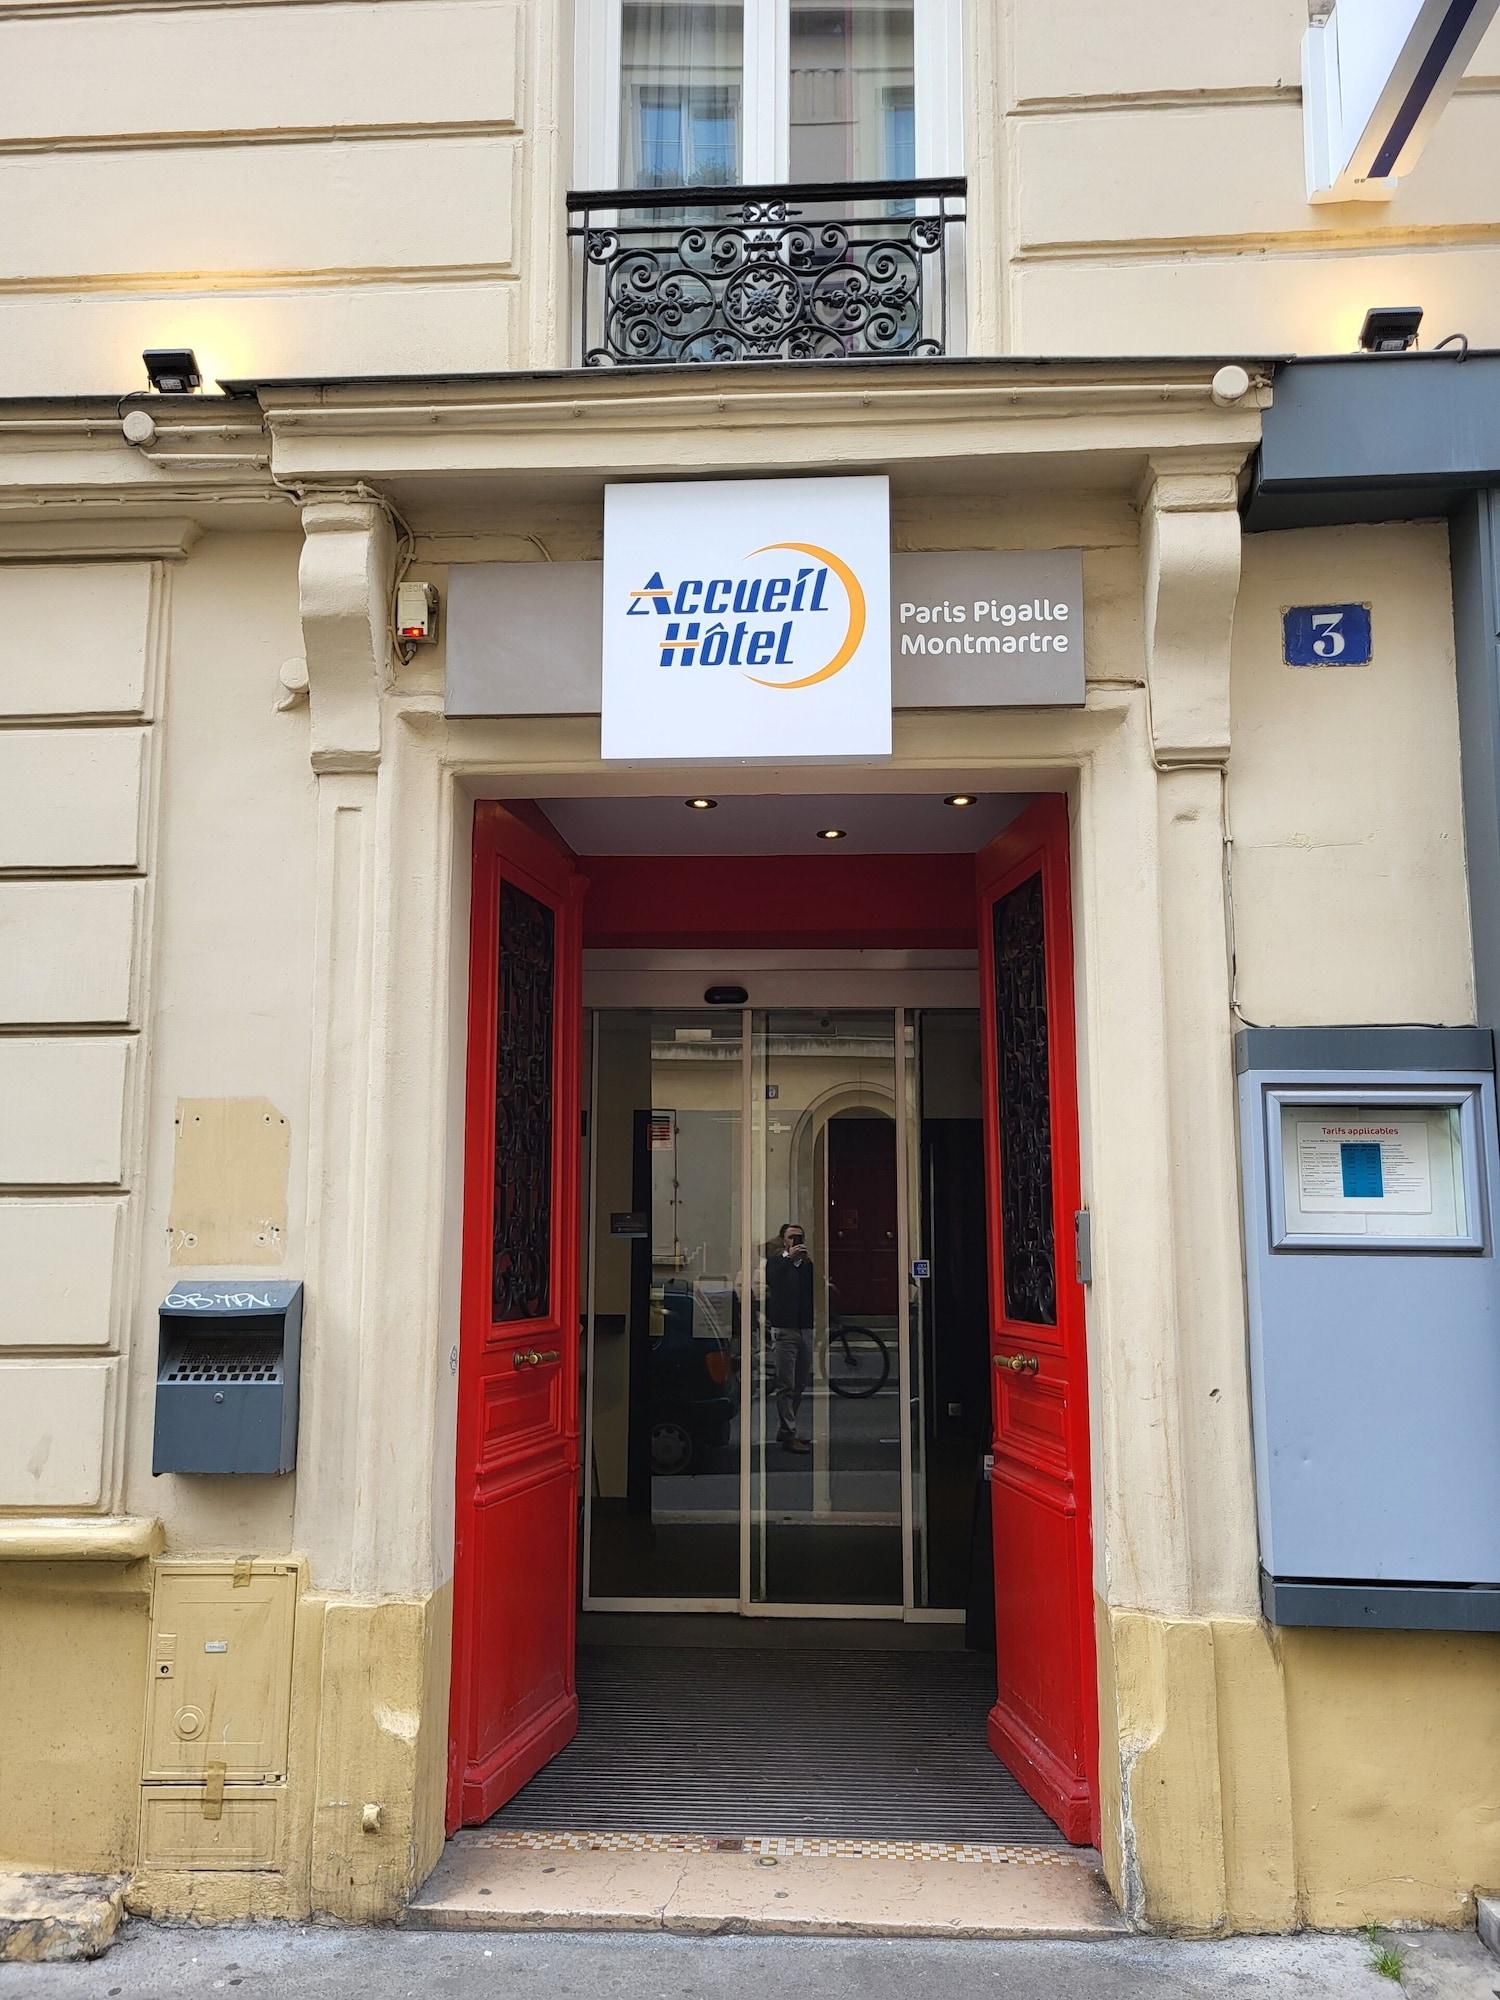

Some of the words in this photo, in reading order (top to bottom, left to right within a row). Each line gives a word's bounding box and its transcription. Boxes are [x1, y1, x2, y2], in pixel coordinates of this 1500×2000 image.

[626, 567, 829, 616] Accueil
[900, 601, 966, 624] Paris
[973, 598, 1069, 627] Pigalle
[659, 620, 794, 668] Hôtel
[901, 632, 1069, 656] Montmartre
[1312, 613, 1345, 657] 3
[1321, 1127, 1346, 1136] Tarifs
[1347, 1127, 1399, 1137] applicables
